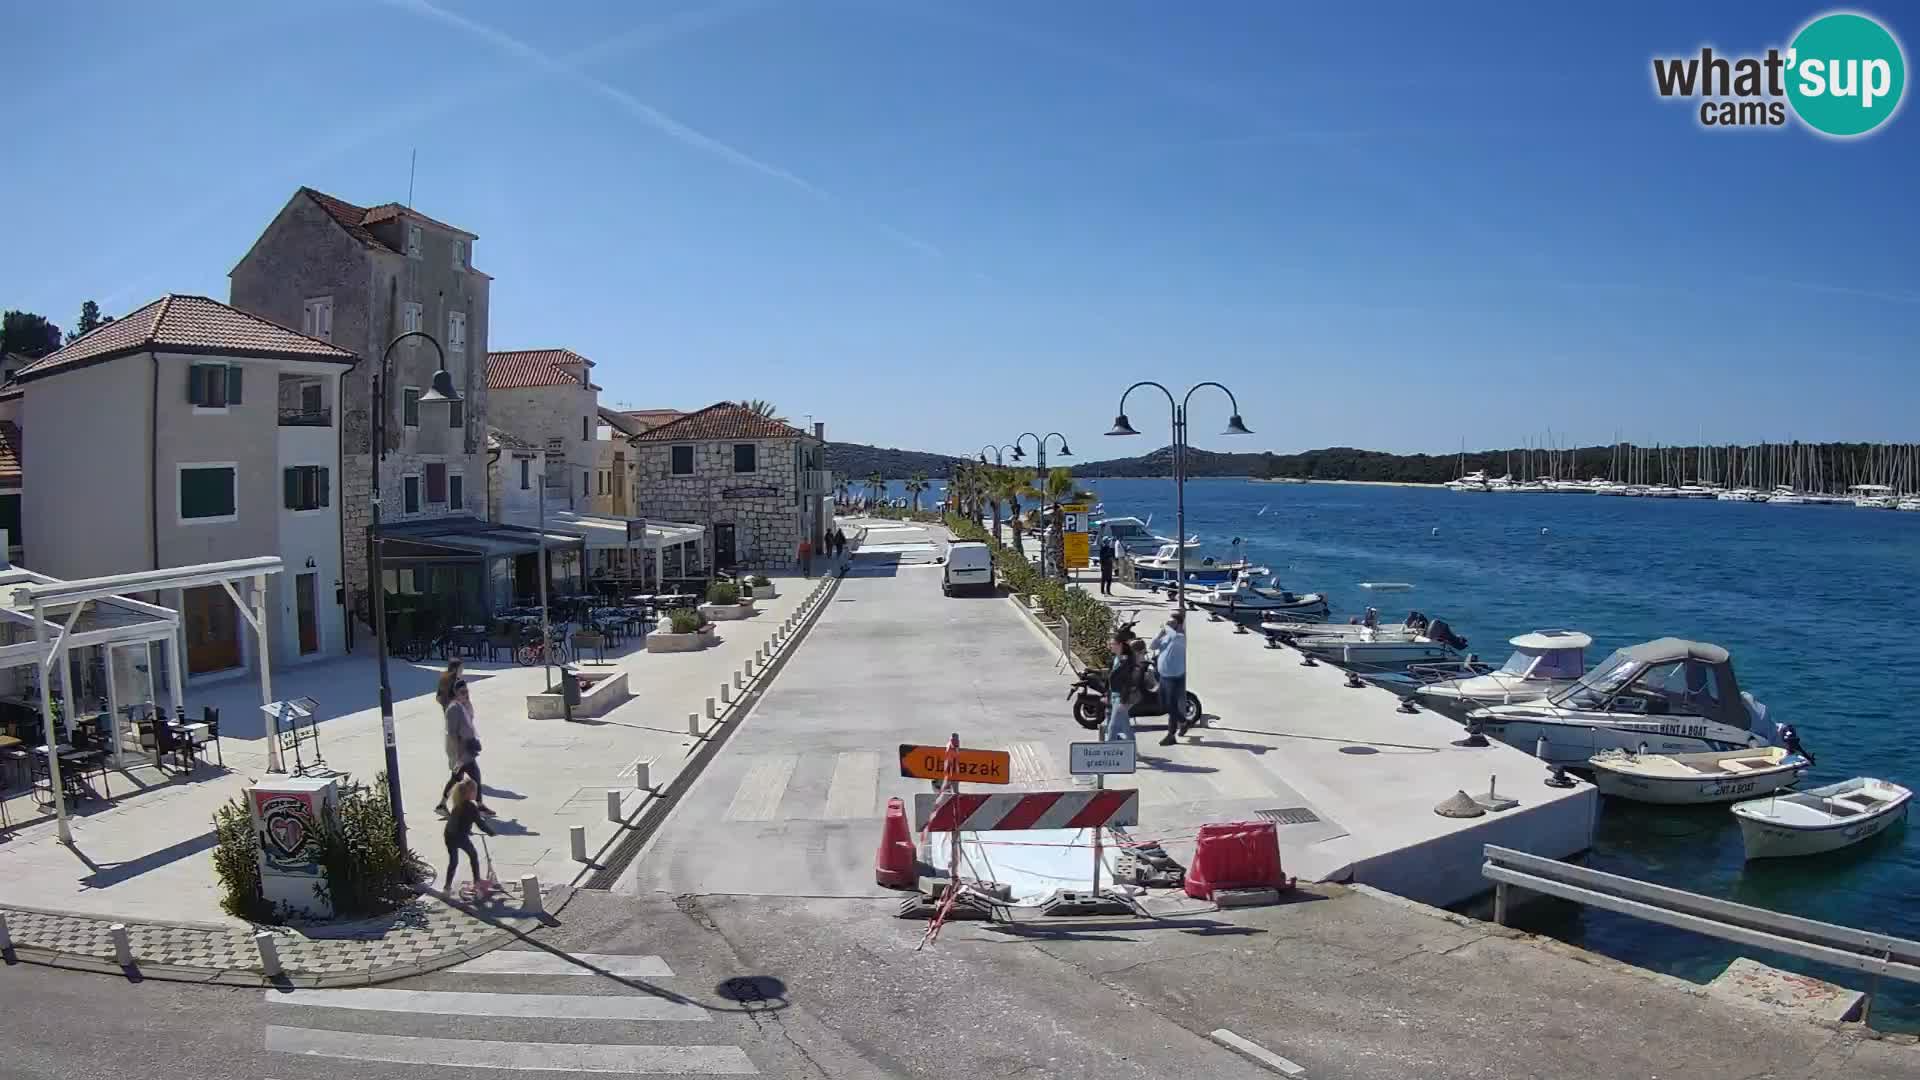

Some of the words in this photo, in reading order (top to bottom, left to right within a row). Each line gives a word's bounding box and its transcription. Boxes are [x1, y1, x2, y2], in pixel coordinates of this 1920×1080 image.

[1660, 723, 1680, 735] RENT
[1688, 726, 1707, 737] BOAT
[924, 755, 1001, 777] Oblazak
